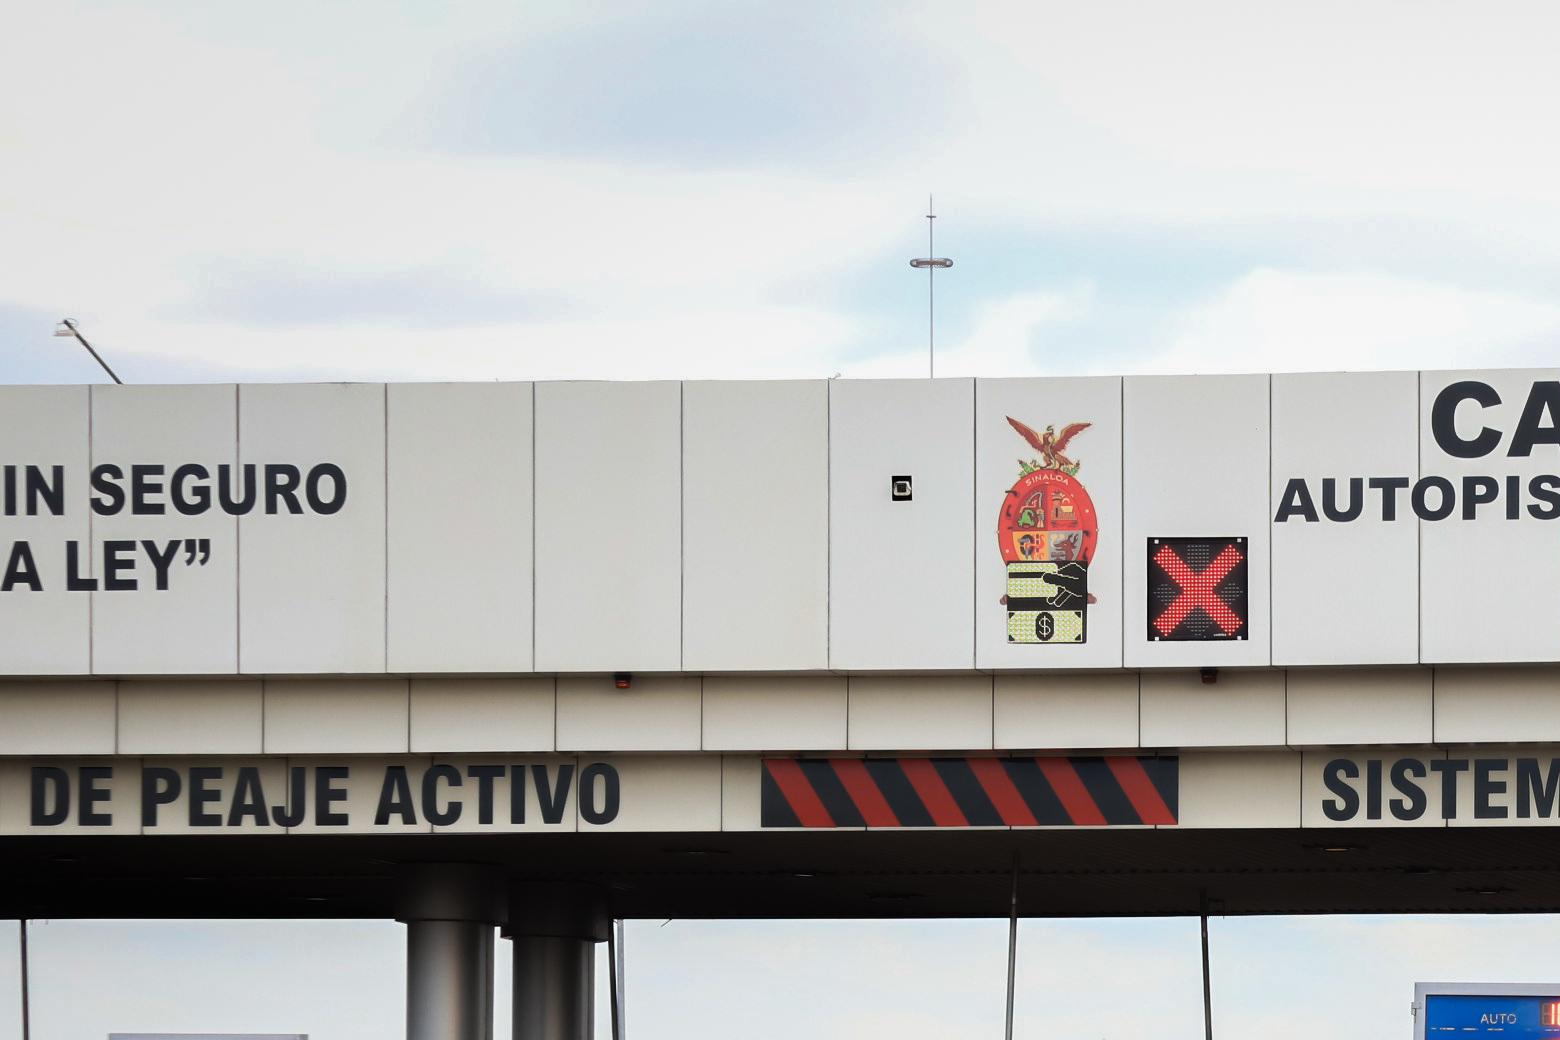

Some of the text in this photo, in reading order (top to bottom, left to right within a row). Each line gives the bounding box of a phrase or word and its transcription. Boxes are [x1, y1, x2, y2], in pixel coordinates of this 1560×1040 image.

[3, 462, 347, 516] IN SEGURO
[1025, 473, 1069, 487] SINALOA
[0, 541, 43, 592] A
[30, 763, 621, 828] DE PEAJE ACTIVO
[1480, 1013, 1517, 1025] AUTO
